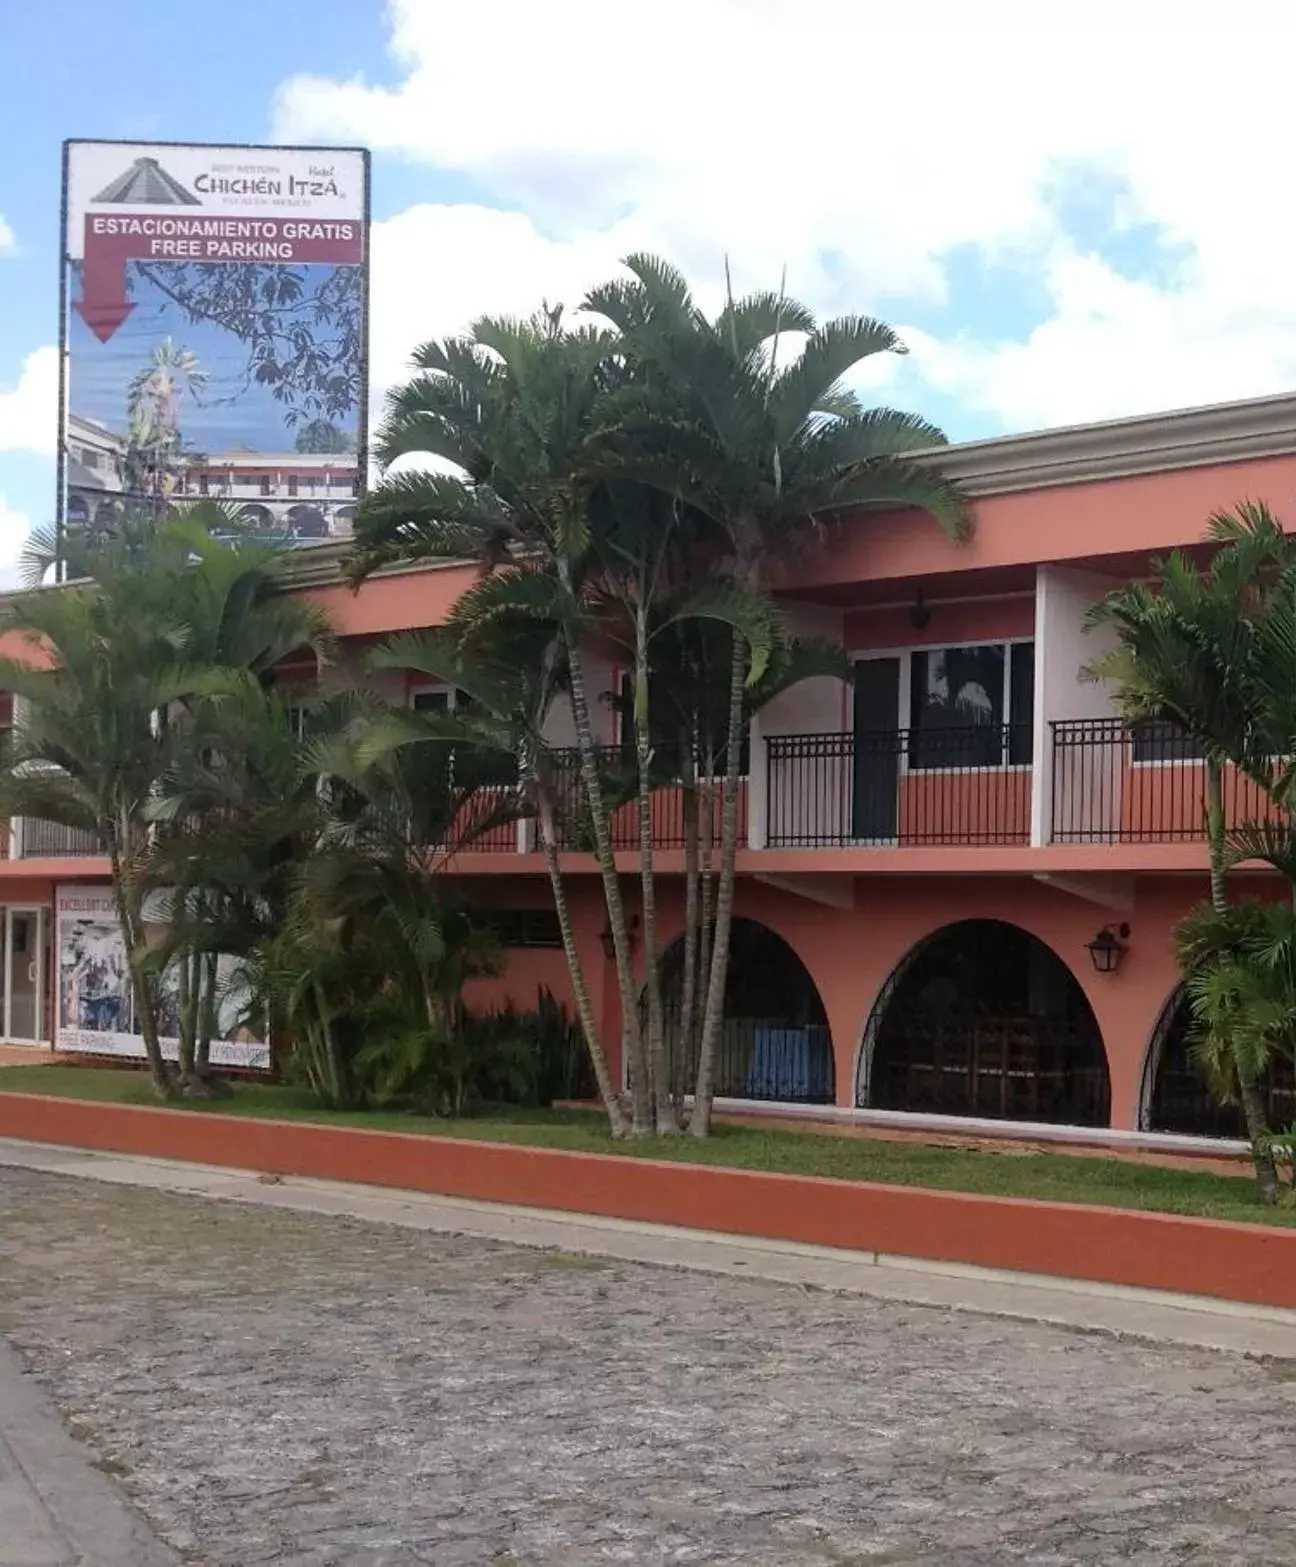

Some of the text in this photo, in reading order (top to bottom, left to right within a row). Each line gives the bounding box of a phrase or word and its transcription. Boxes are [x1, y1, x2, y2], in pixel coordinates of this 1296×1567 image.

[93, 218, 353, 240] ESTACIONAMIENTO GRATIS
[151, 239, 293, 259] FREE PARKING
